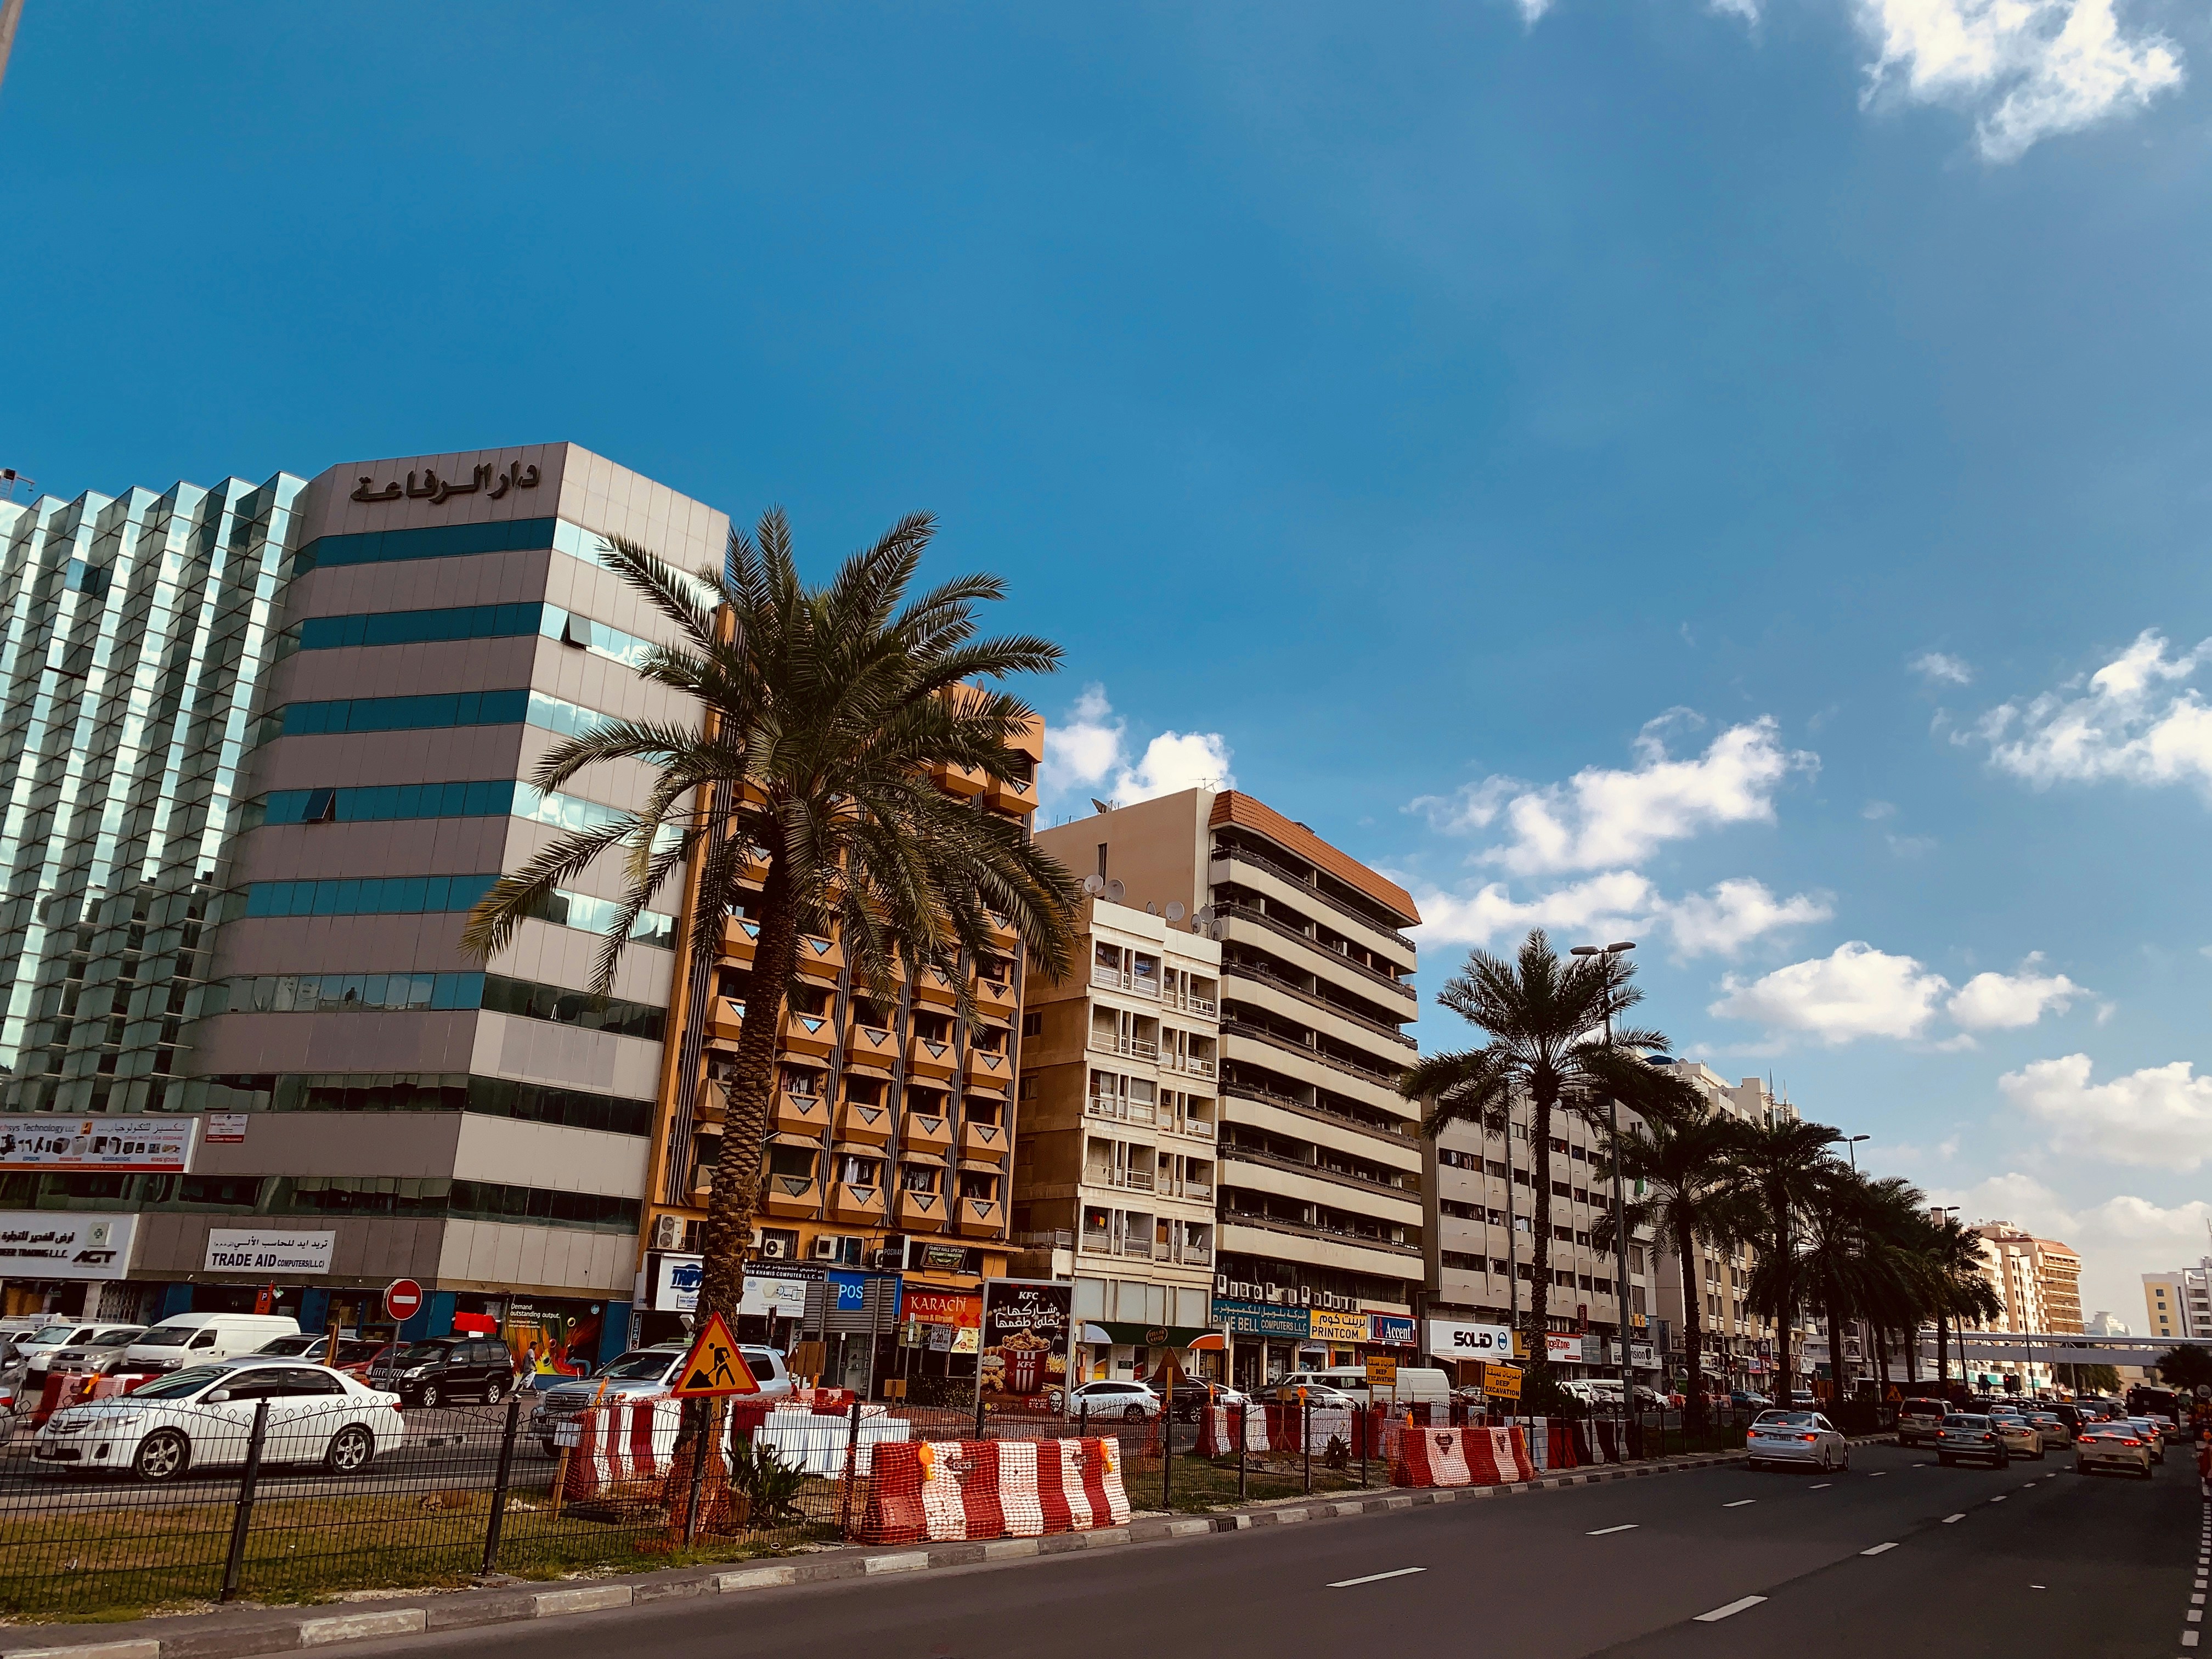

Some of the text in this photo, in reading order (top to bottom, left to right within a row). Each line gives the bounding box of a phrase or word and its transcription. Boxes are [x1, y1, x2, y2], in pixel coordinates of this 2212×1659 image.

[487, 460, 541, 498] دار
[23, 1123, 64, 1133] Technology
[312, 1240, 328, 1249] تريد
[72, 1250, 116, 1263] AGT
[212, 1252, 252, 1266] TRADE
[255, 1254, 276, 1267] AID
[839, 1284, 864, 1299] POS
[1018, 1291, 1039, 1300] KFC
[510, 1311, 540, 1319] outstanding
[1007, 1301, 1058, 1317] شاركها
[996, 1312, 1031, 1328] طعمها
[1238, 1317, 1259, 1332] BELL
[1261, 1319, 1293, 1331] COMPUTERS
[1319, 1314, 1365, 1329] برينت كوم
[936, 1333, 943, 1343] 20
[1312, 1325, 1358, 1340] PRINTCOM
[1385, 1321, 1411, 1340] Accent
[1629, 1347, 1645, 1359] ision
[1485, 1385, 1520, 1397] EXCAVATION
